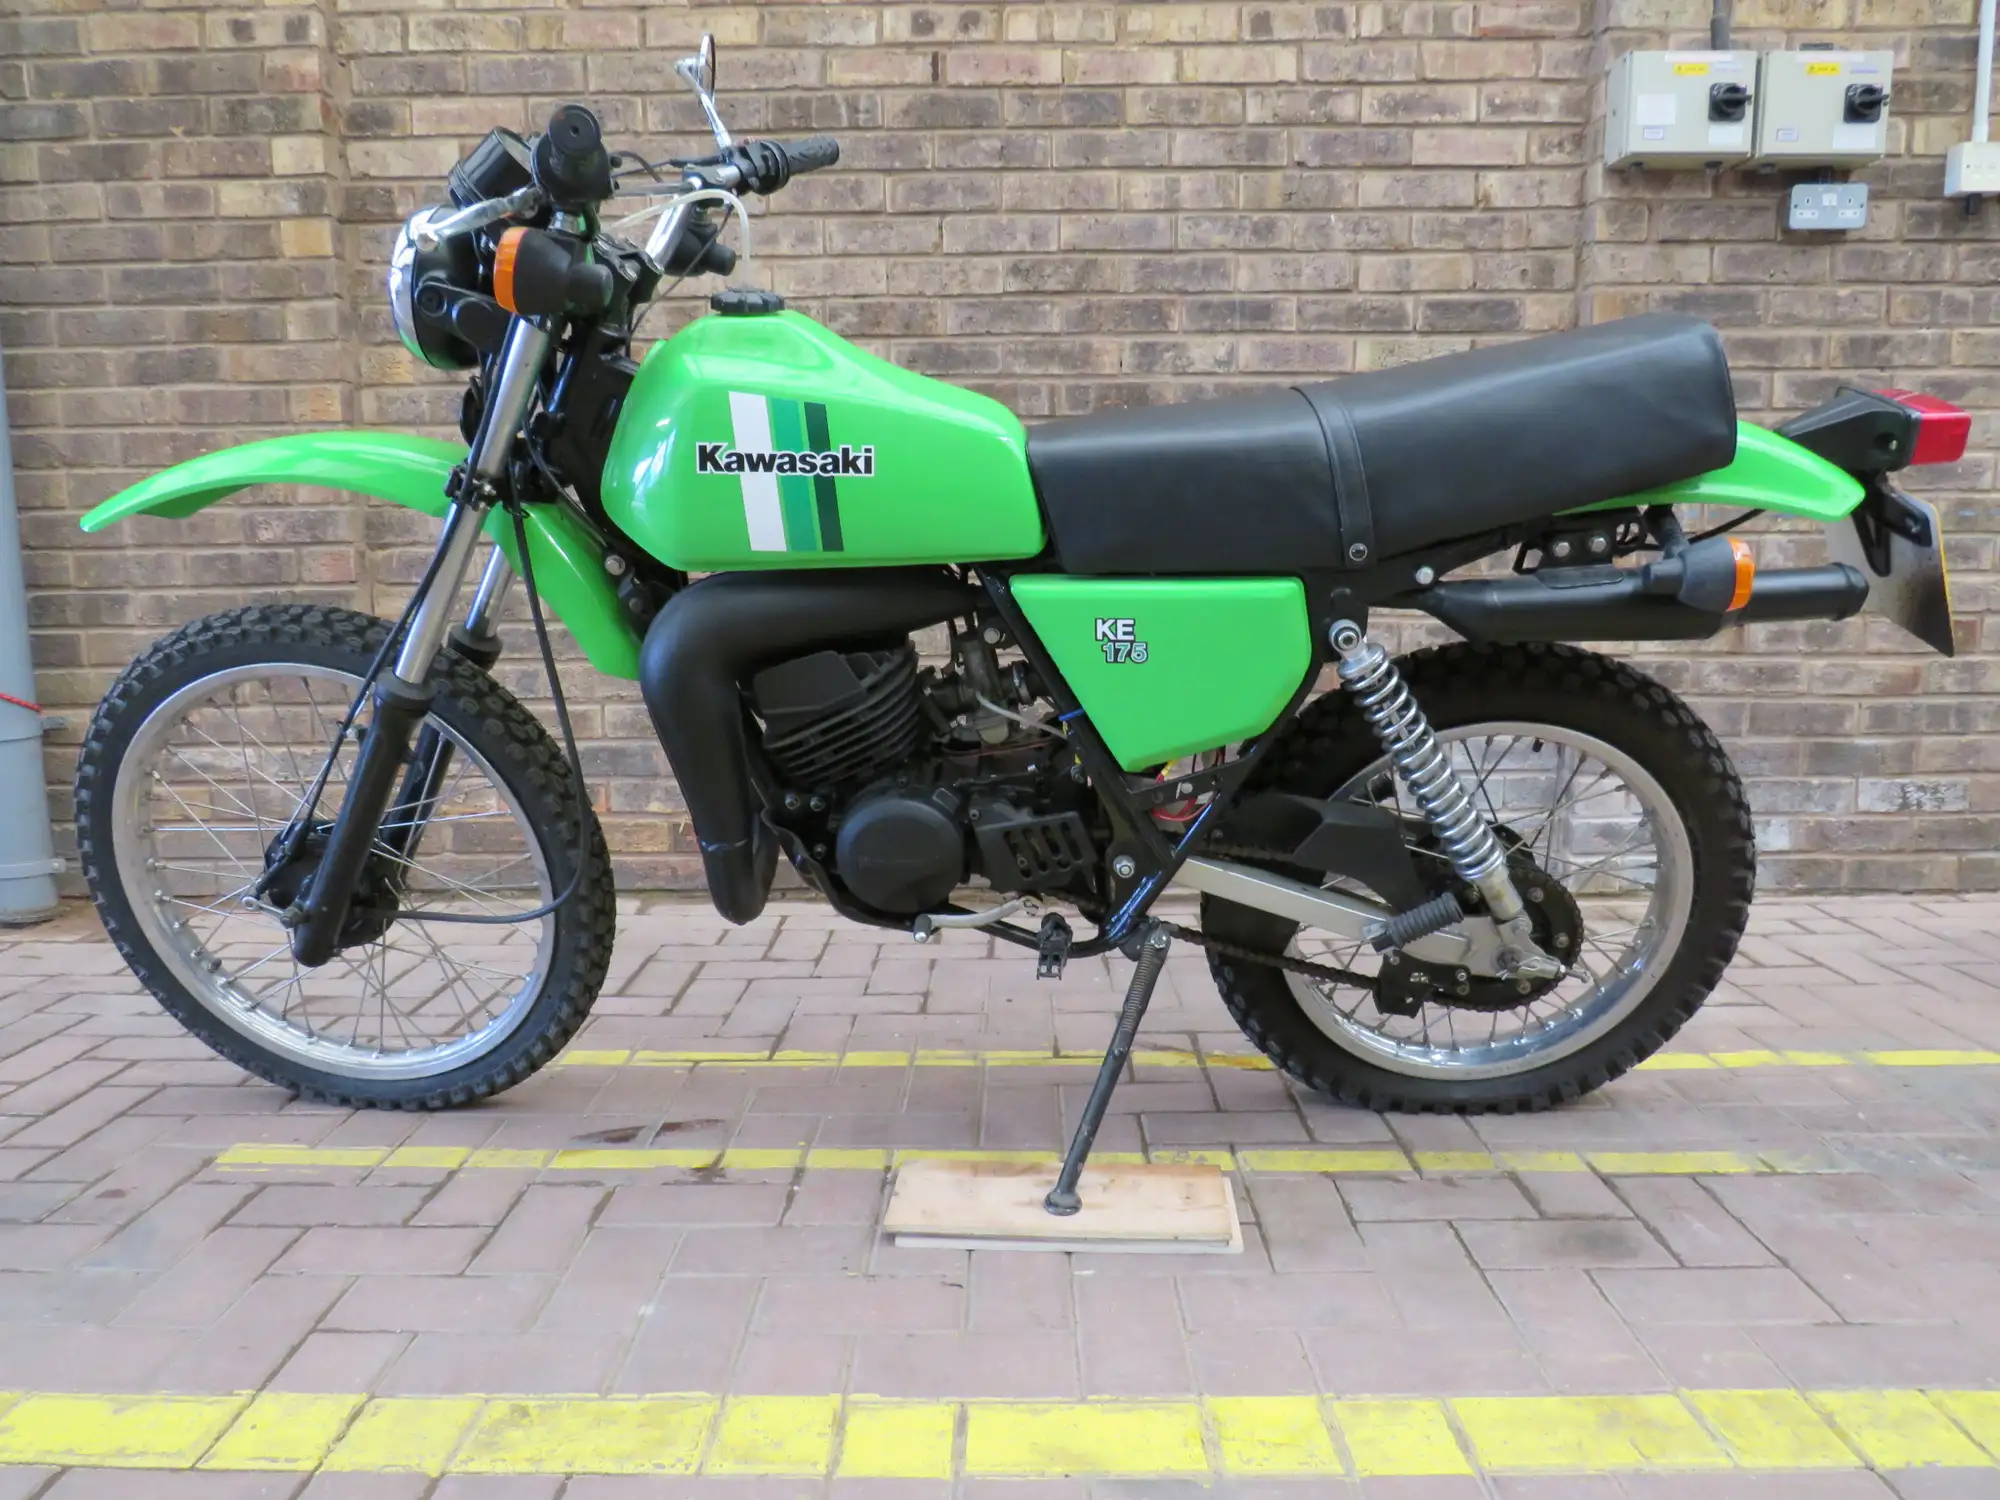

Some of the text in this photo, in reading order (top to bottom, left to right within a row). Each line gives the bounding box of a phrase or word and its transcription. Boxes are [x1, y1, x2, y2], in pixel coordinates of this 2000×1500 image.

[697, 443, 874, 476] Kawasaki
[1095, 618, 1135, 641] KE
[1102, 641, 1148, 663] 175
